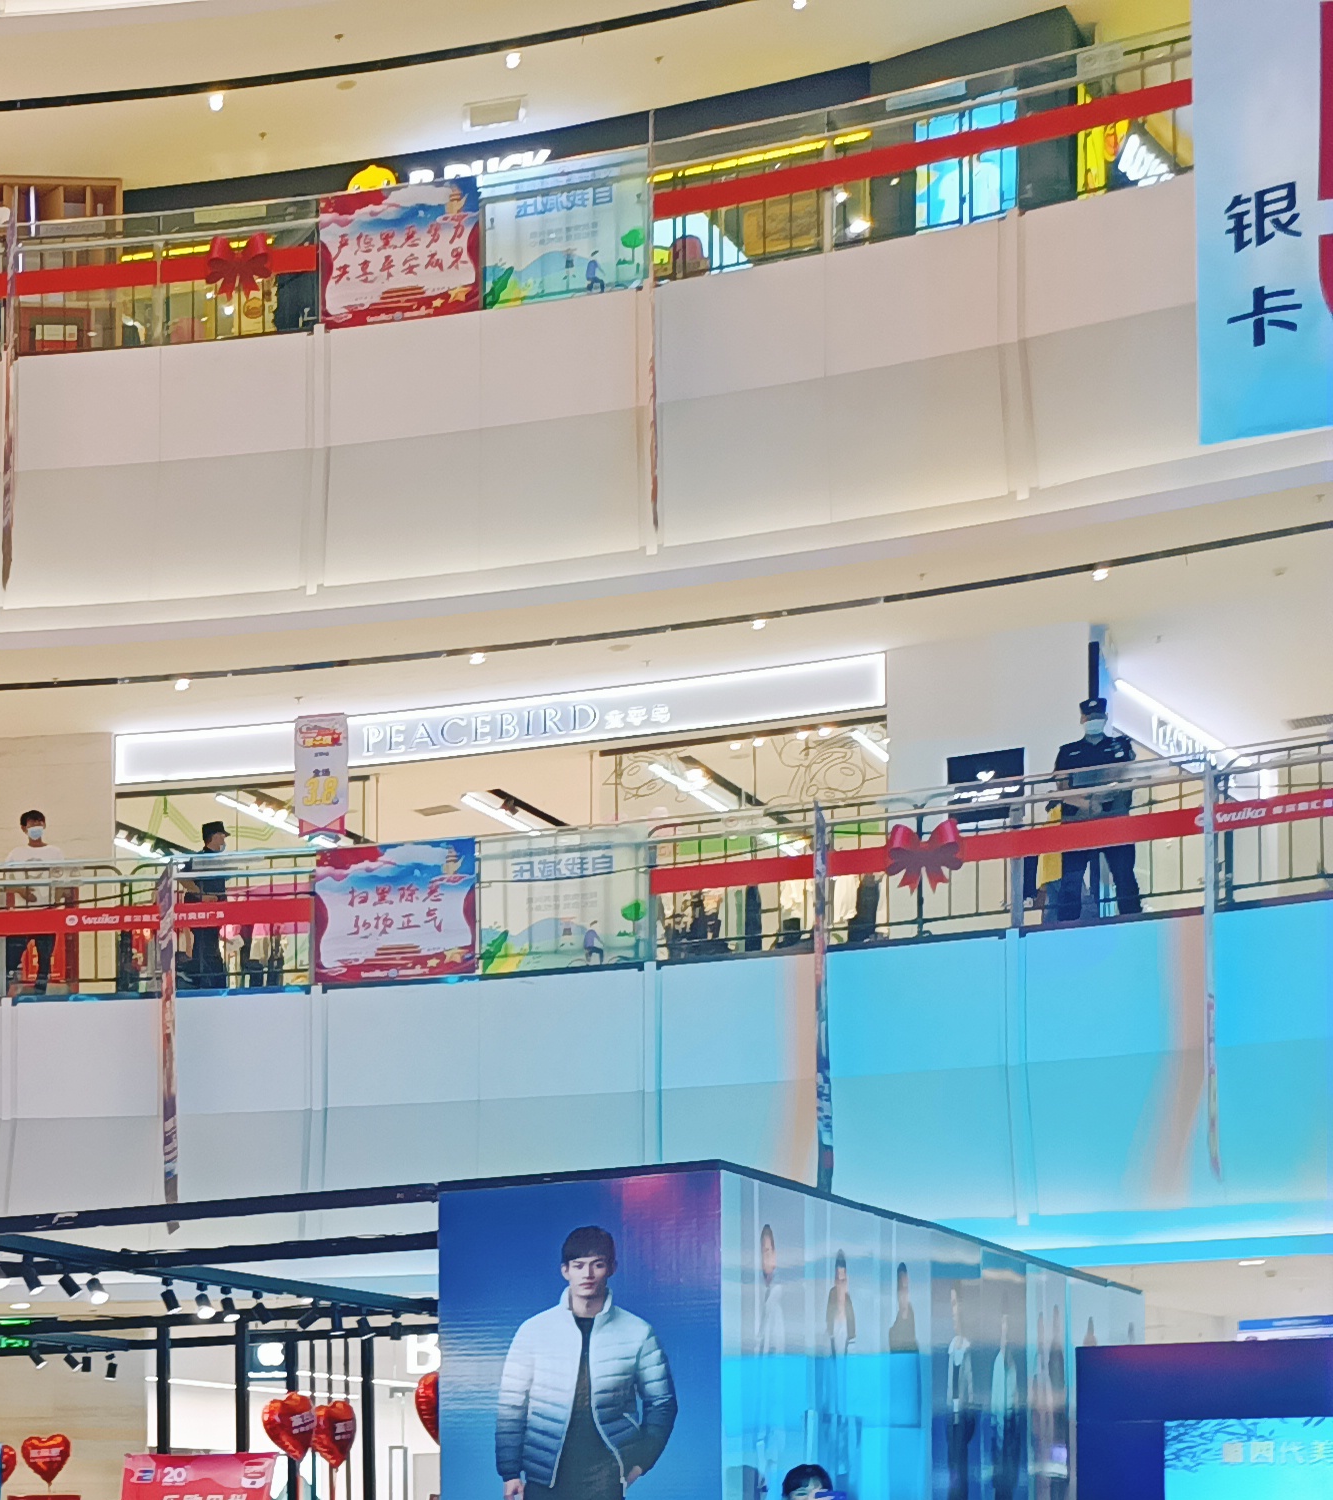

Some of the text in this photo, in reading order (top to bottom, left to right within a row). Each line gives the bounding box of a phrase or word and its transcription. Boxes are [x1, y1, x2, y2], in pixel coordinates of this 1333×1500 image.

[1224, 181, 1303, 347] 银卡
[361, 703, 600, 757] PEACEBIRD
[348, 881, 445, 908] 扫黑除恶
